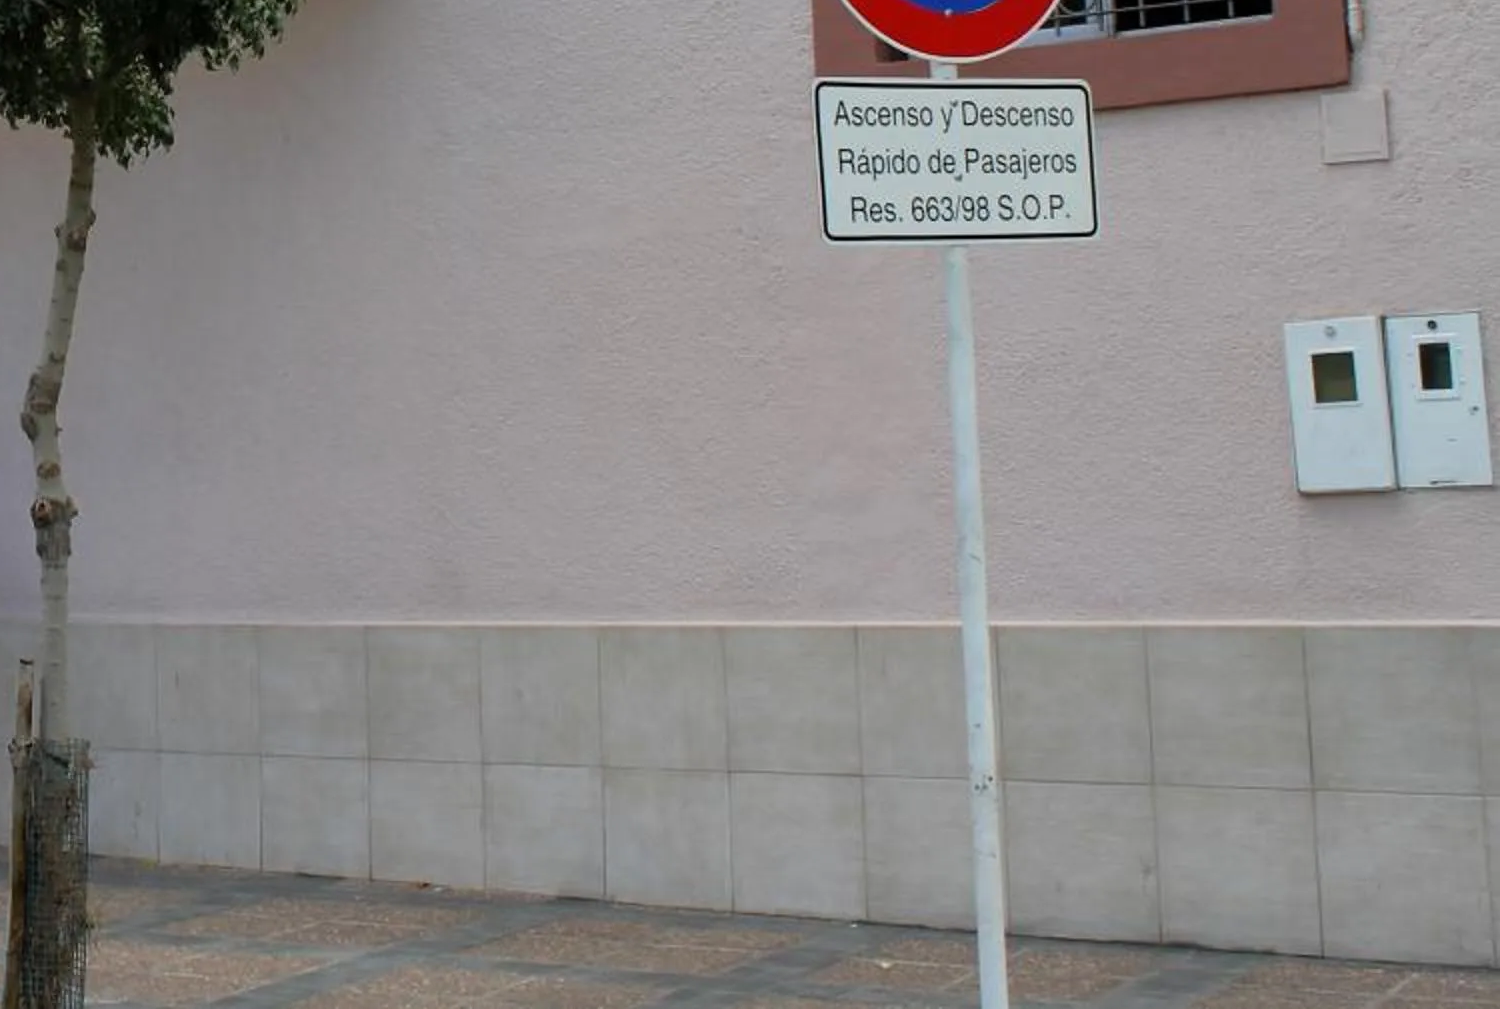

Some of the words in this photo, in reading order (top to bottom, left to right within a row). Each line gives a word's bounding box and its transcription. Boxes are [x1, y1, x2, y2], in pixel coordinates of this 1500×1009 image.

[834, 100, 933, 128] Ascenso
[940, 105, 954, 134] y
[961, 100, 1075, 127] Descenso
[837, 148, 921, 181] Rápido
[928, 149, 957, 174] de
[964, 147, 1077, 180] Pasajeros
[851, 196, 904, 223] Res.
[911, 195, 991, 222] 663/98
[998, 193, 1072, 221] S.O.P.
